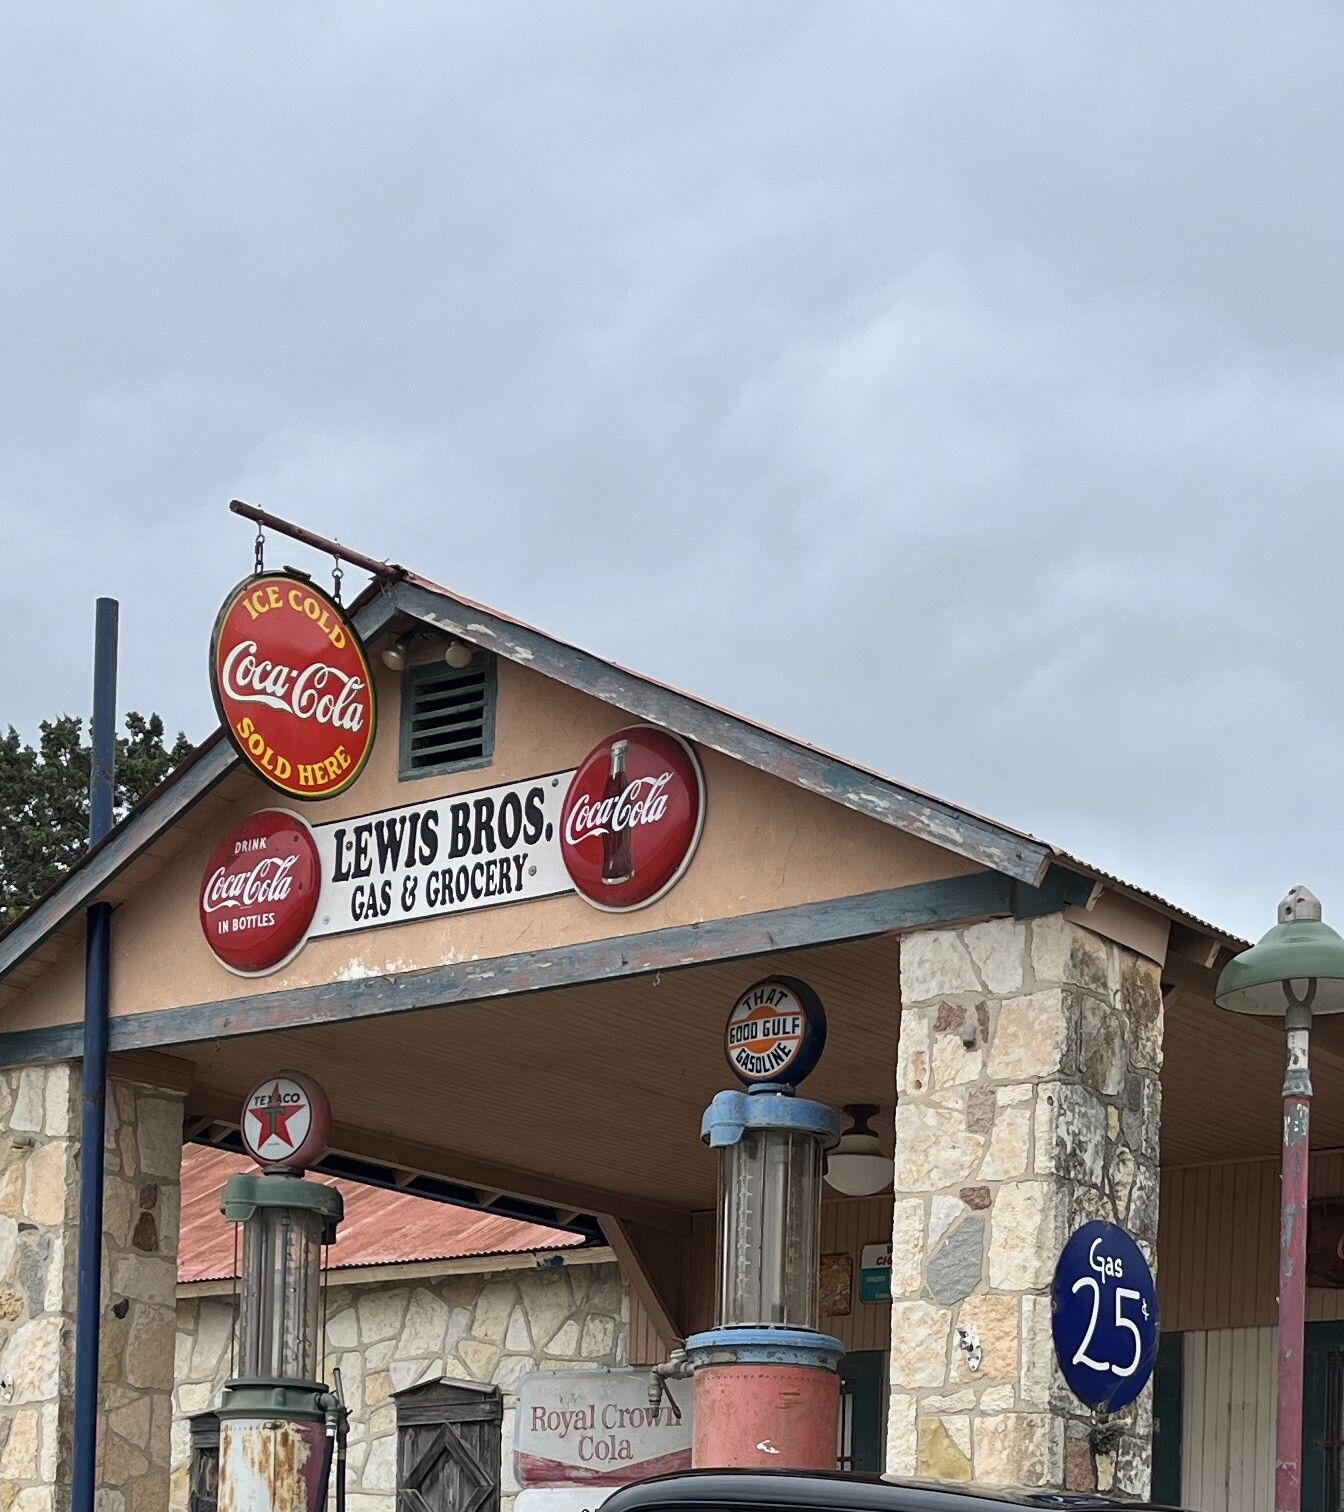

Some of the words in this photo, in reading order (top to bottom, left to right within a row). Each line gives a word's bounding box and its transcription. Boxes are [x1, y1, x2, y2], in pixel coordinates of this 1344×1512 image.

[243, 586, 284, 620] ICE
[288, 589, 346, 649] COLD
[222, 640, 365, 733] Coca-Cola
[237, 717, 292, 780] SOLD
[297, 745, 352, 786] HERE
[565, 771, 675, 846] Coca-Cola
[234, 836, 267, 854] DRINK
[331, 809, 439, 883] LEWIS
[447, 786, 554, 860] BROS.
[203, 854, 300, 913] Coca-Cola
[350, 879, 393, 922] GAS
[400, 870, 419, 912] &
[425, 852, 529, 909] GROCERY
[218, 921, 230, 934] IN
[232, 912, 275, 933] BOTTLES
[742, 988, 789, 1012] THAT
[729, 1021, 758, 1044] GOOD
[762, 1016, 800, 1037] GULF
[735, 1042, 792, 1074] GASOLINE
[254, 1092, 301, 1107] TEXACO
[262, 1106, 287, 1135] T
[1089, 1237, 1123, 1285] Gas
[531, 1405, 596, 1438] Royal
[601, 1403, 682, 1431] Crown
[578, 1434, 634, 1461] Cola
